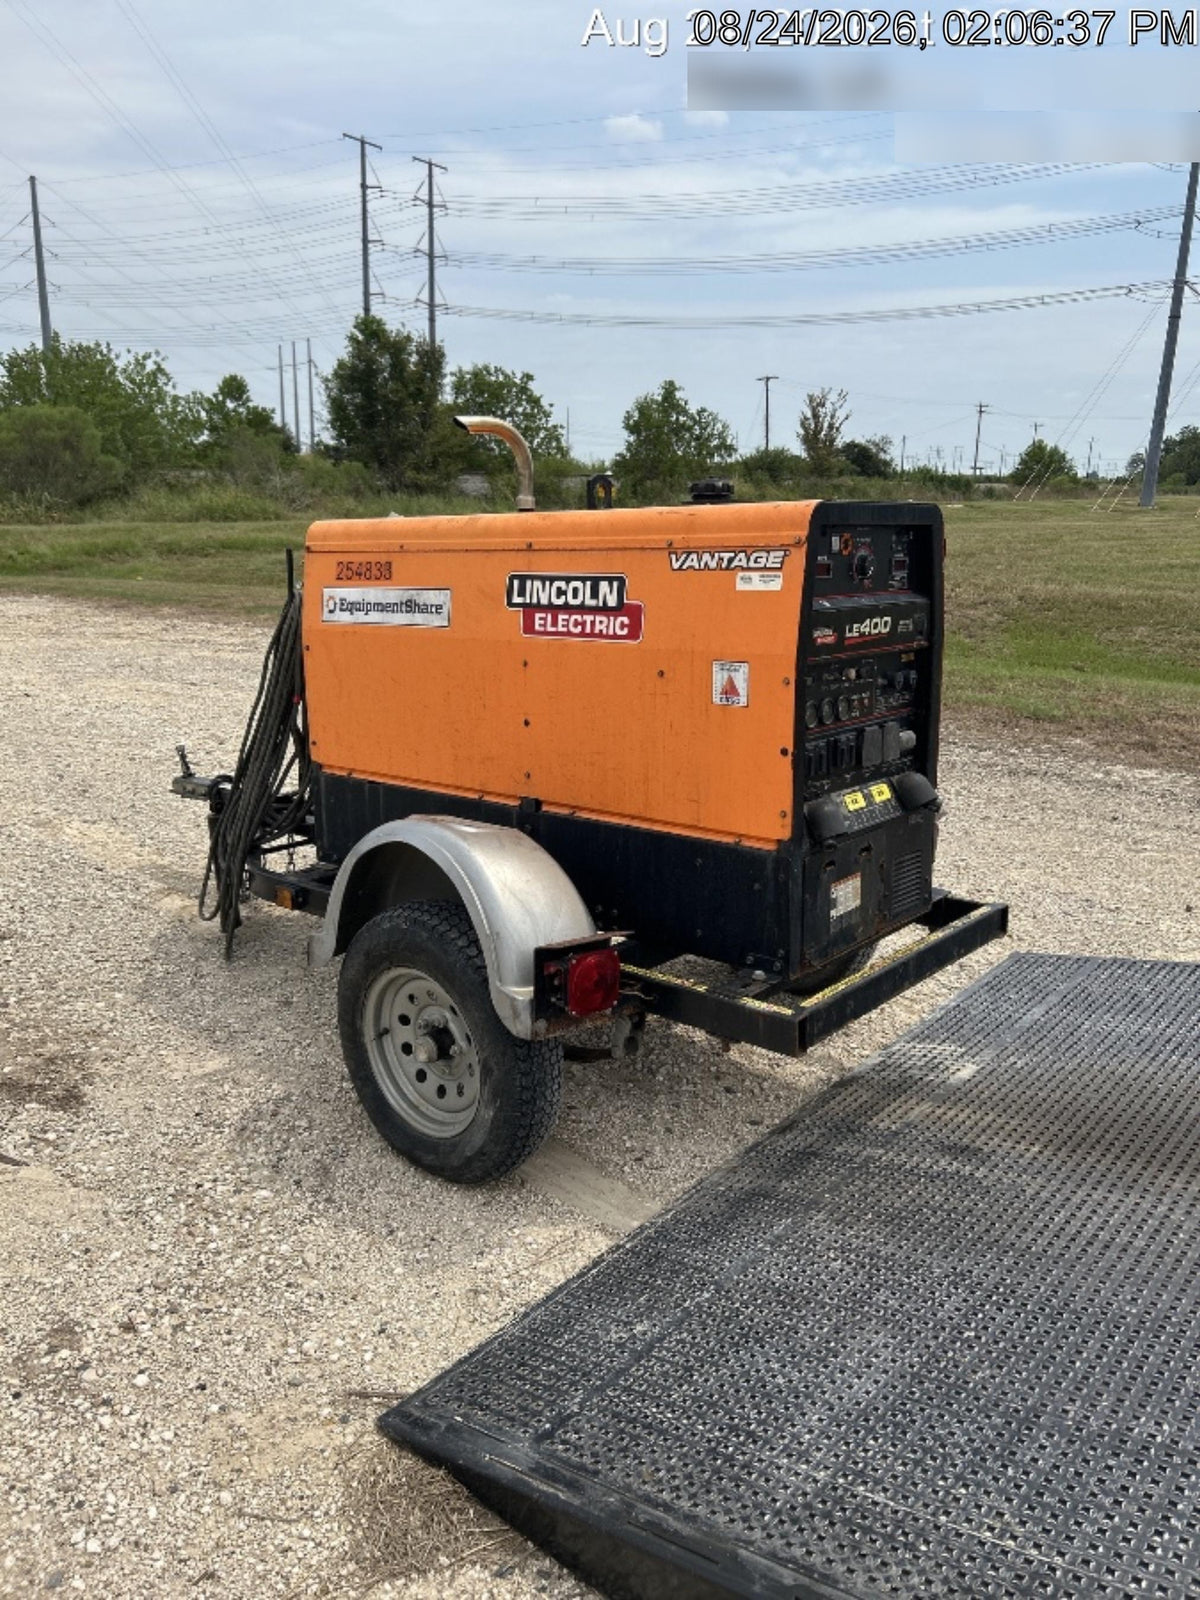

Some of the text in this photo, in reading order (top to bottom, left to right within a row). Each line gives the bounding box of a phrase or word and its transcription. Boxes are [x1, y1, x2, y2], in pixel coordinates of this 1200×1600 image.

[669, 550, 786, 570] VANTAGE
[511, 578, 619, 607] LINCOLN
[338, 597, 445, 616] EquipmentShare
[533, 612, 630, 636] ELECTRIC
[845, 616, 892, 637] LE400
